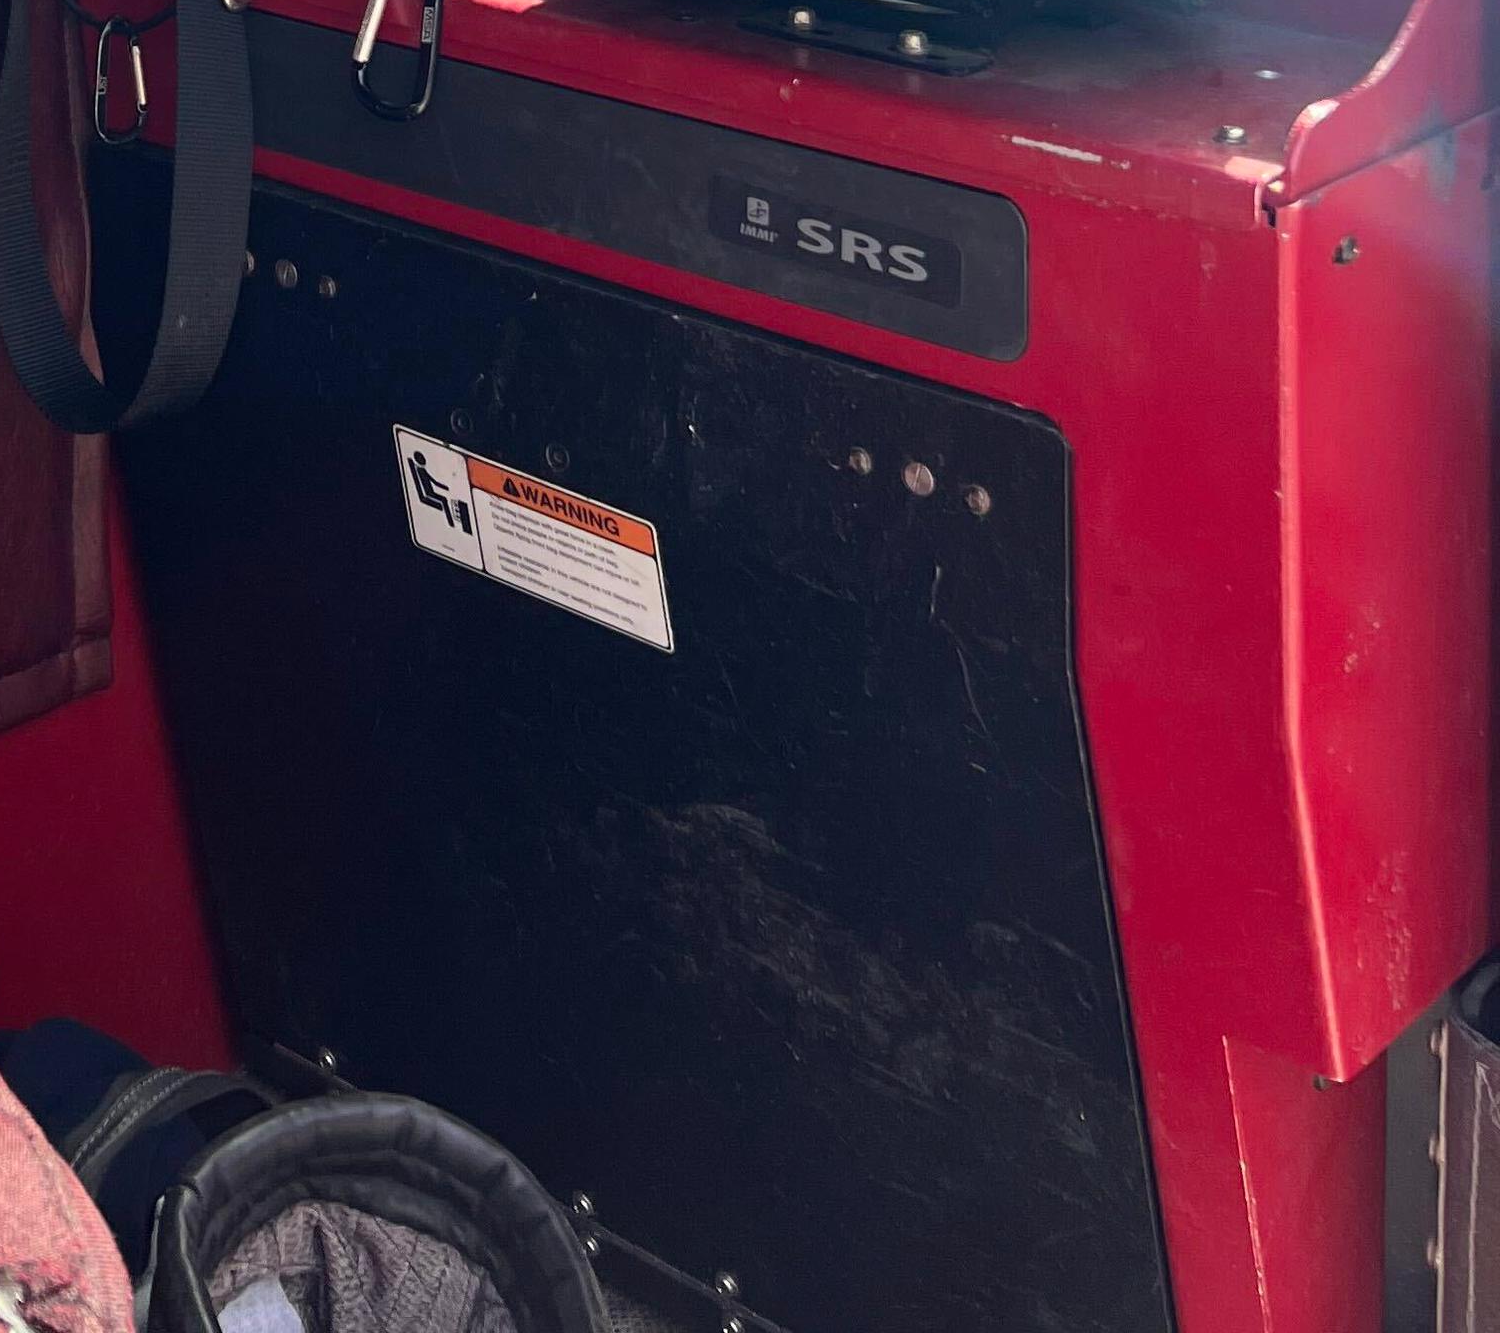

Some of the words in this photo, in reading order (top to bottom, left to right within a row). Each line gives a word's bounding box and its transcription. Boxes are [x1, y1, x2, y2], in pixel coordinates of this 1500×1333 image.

[739, 222, 776, 243] IMMI
[795, 217, 929, 282] SRS
[519, 482, 621, 537] WARNING
